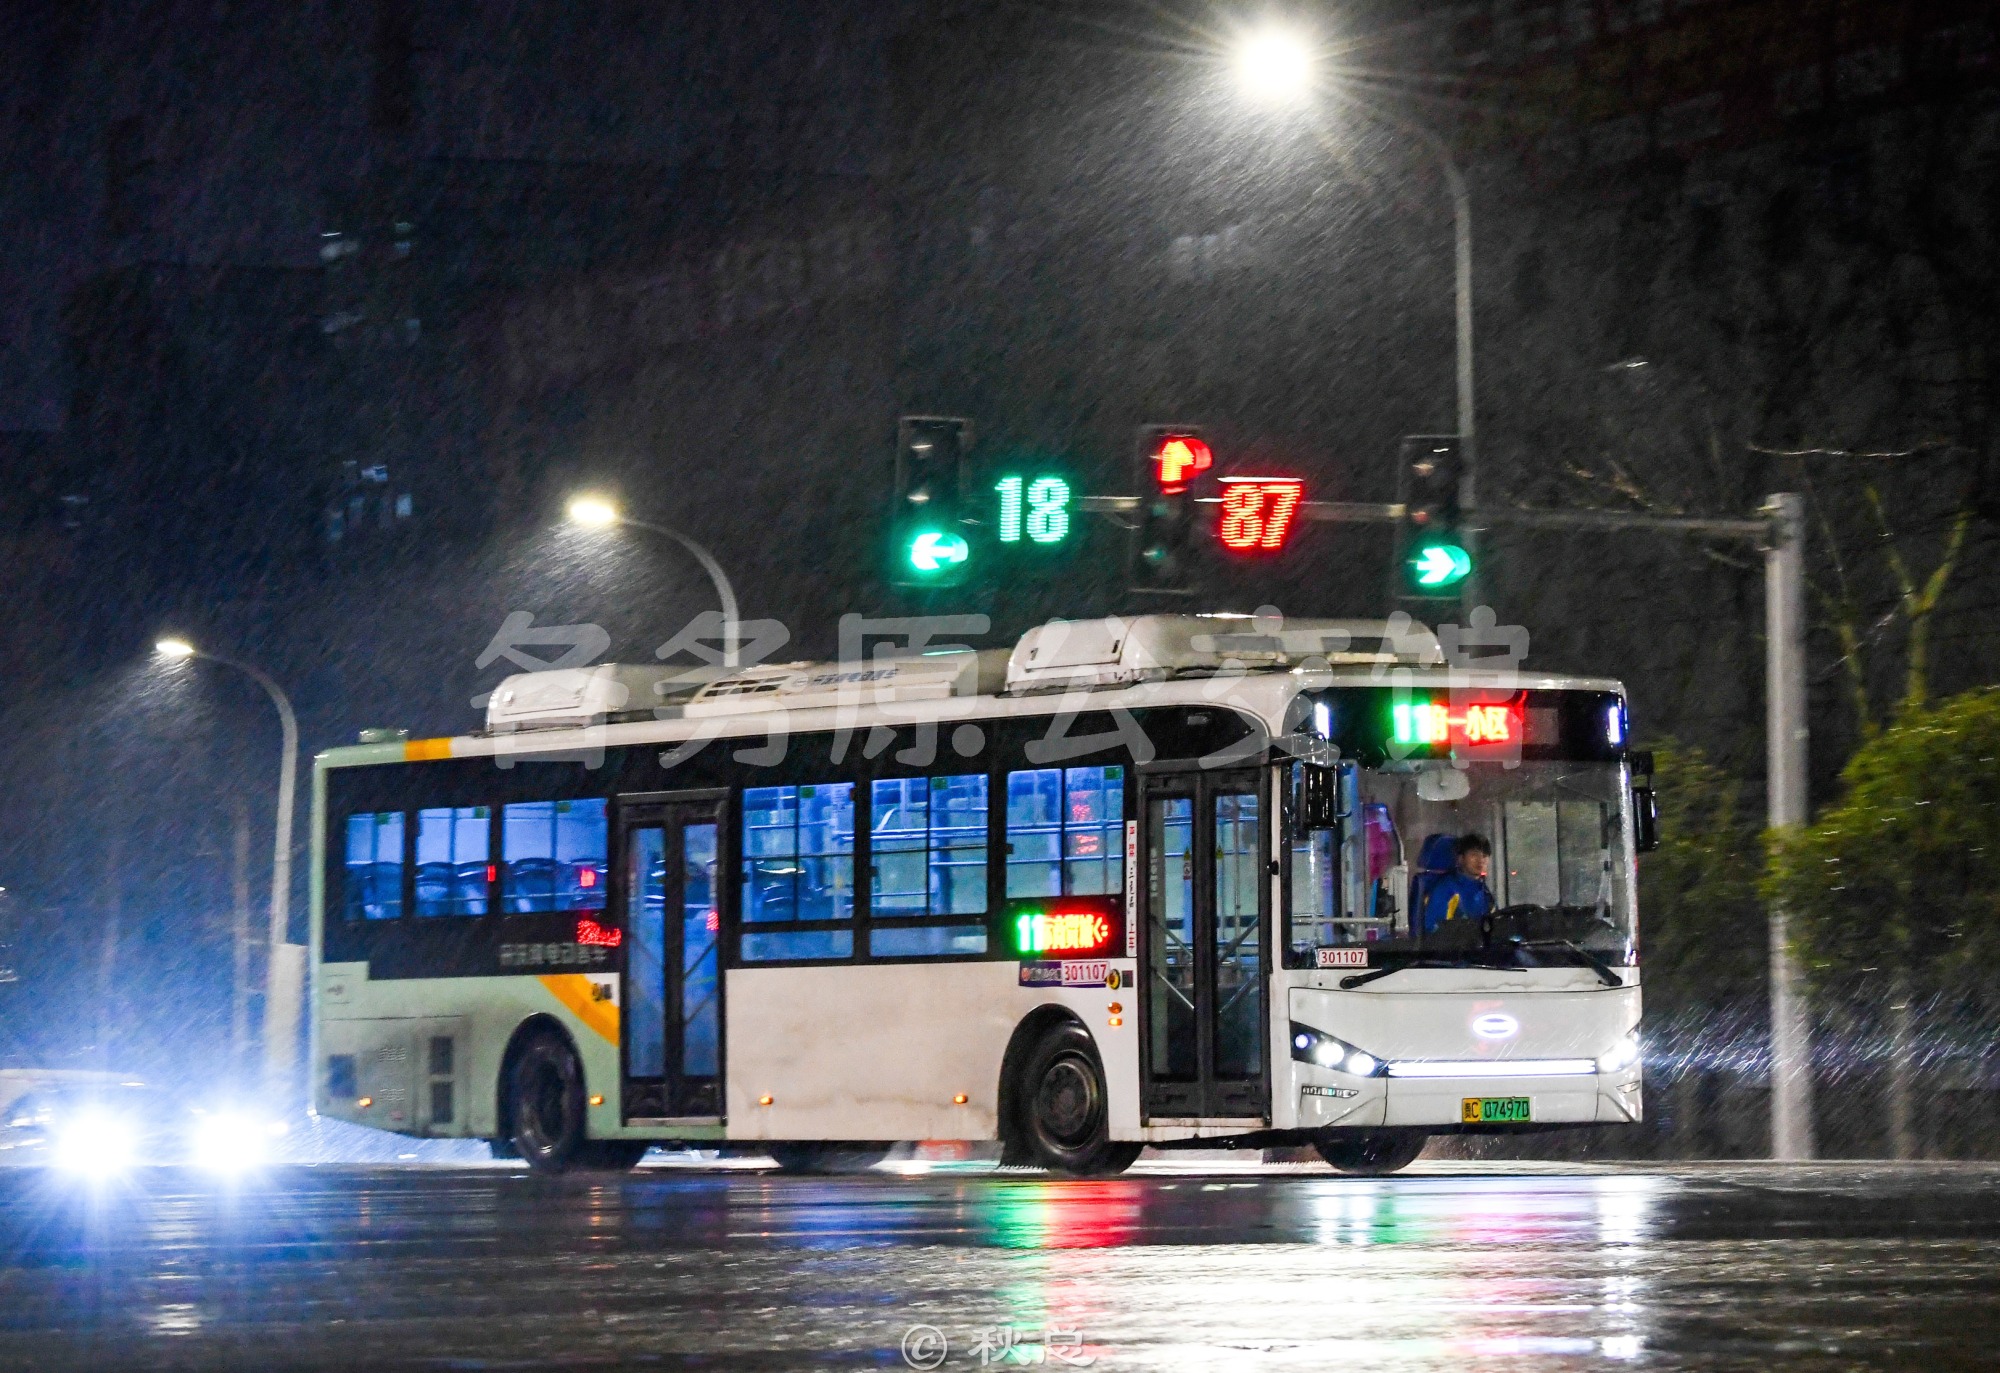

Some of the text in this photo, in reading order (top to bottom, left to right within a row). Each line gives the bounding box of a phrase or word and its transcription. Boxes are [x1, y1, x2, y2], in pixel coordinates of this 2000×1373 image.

[994, 476, 1070, 543] 18
[1220, 483, 1301, 548] 87
[1064, 963, 1107, 981] 301107
[1321, 951, 1364, 964] 301107
